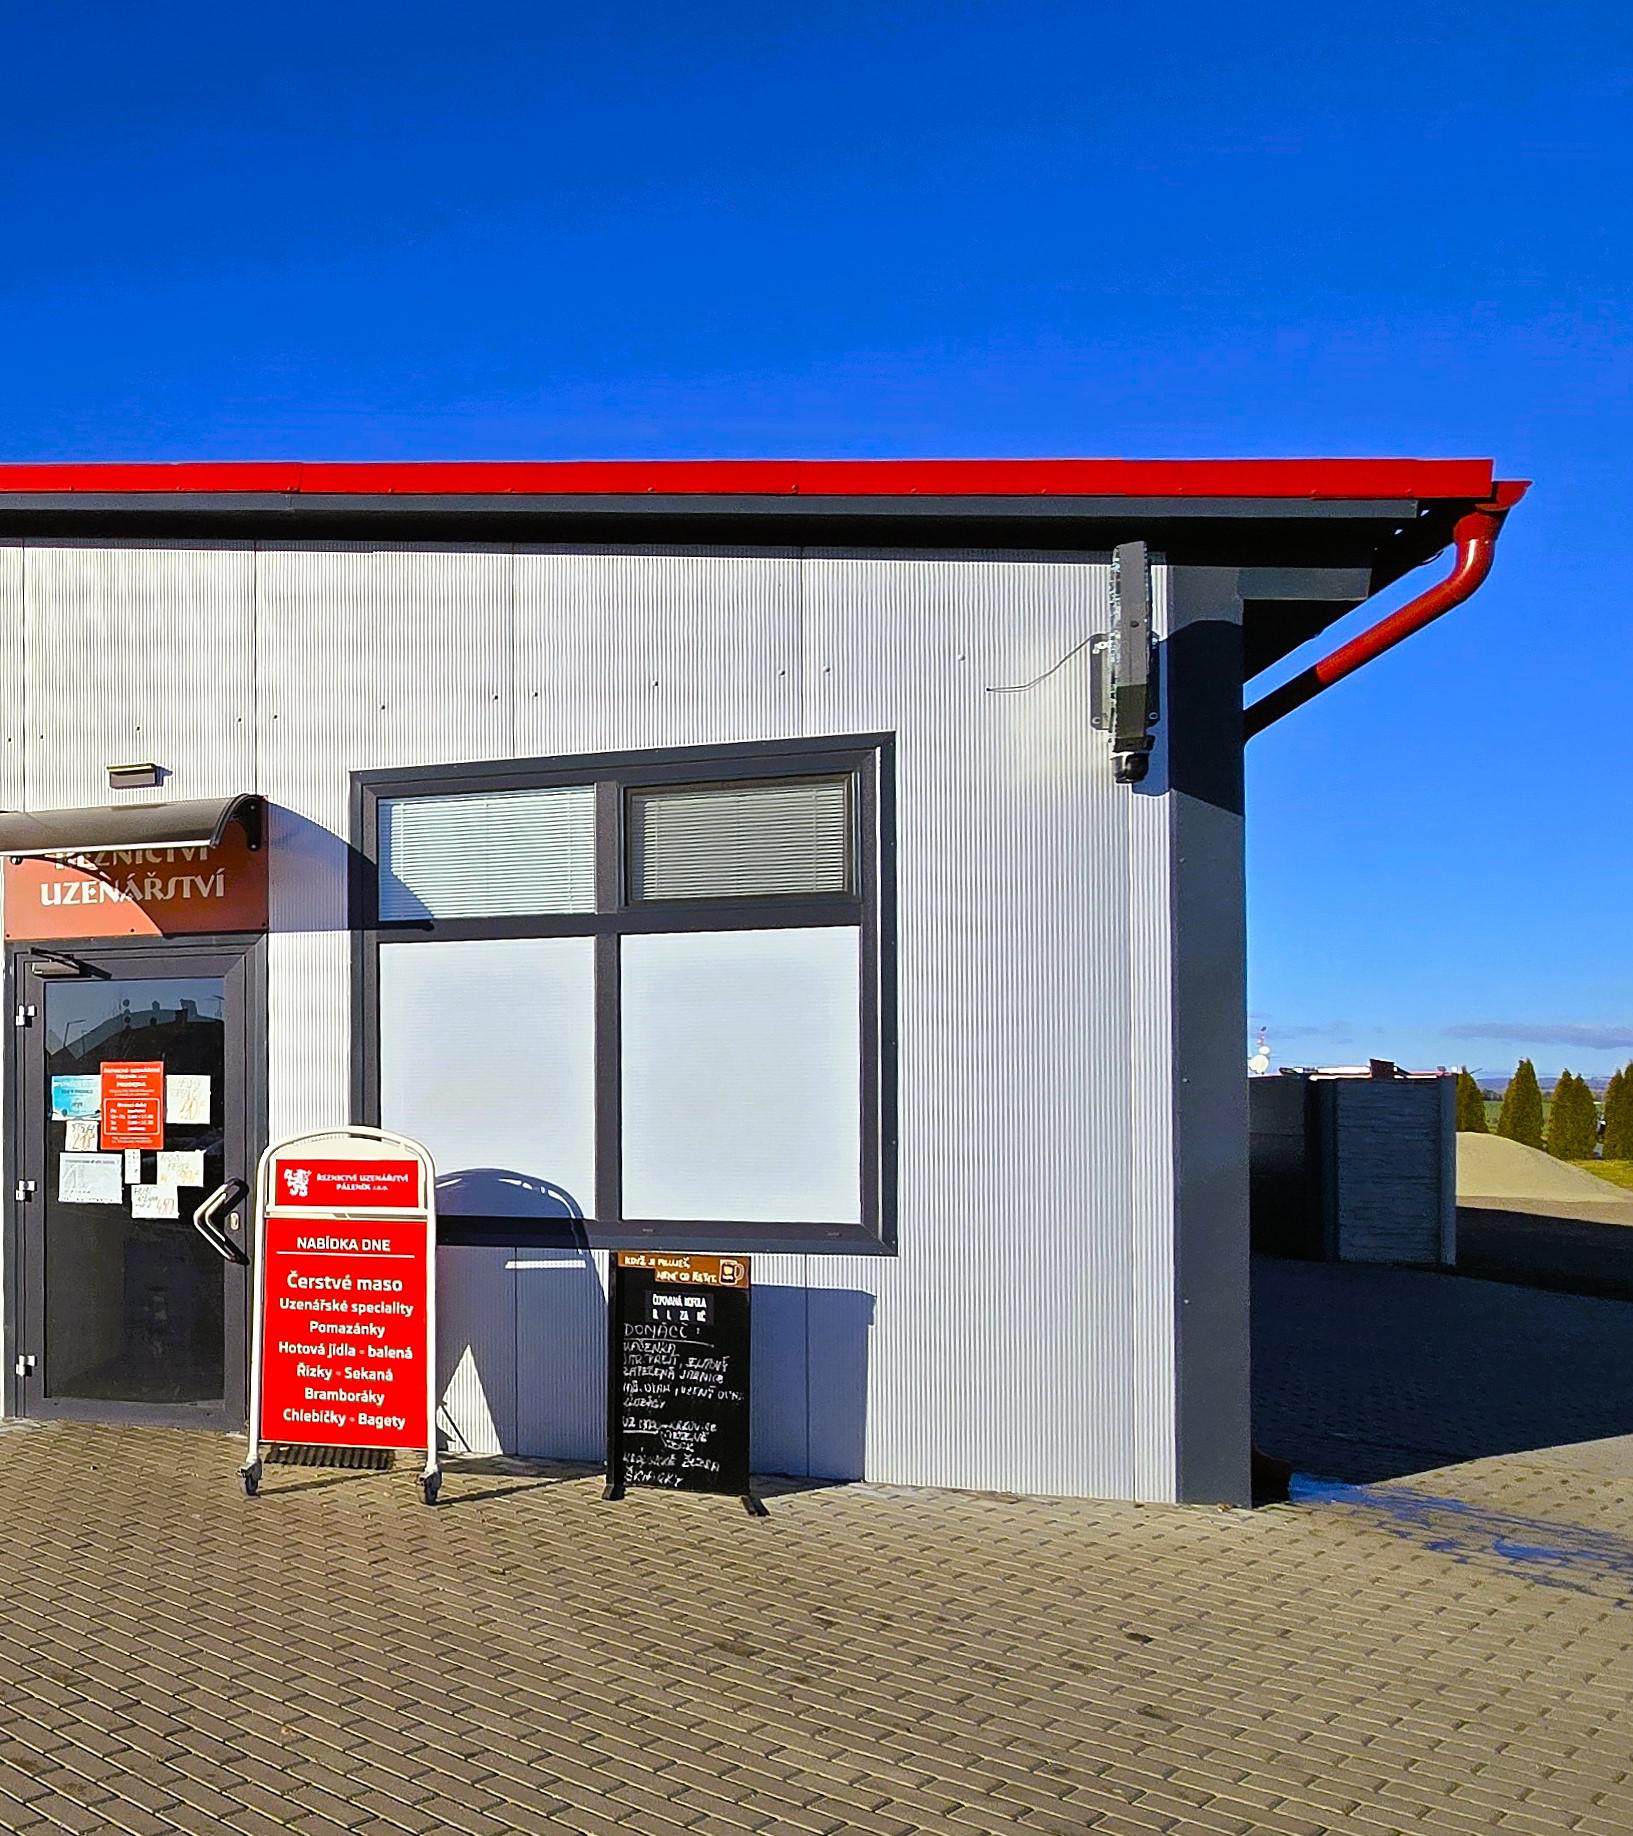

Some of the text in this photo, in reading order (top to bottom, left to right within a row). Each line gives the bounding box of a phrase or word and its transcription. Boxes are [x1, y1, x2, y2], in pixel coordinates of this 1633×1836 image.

[40, 868, 225, 906] UZENÁŘSTVÍ
[296, 1235, 391, 1252] NABÍDKA DNE
[287, 1270, 403, 1292] Čerstvé maso
[279, 1298, 414, 1317] Uzenářské speciality
[309, 1320, 386, 1339] Pomazánky
[278, 1341, 325, 1356] Hotová
[327, 1343, 356, 1359] jídla
[368, 1345, 414, 1360] balená
[296, 1362, 333, 1381] Řízky
[344, 1366, 394, 1382] Sekaná
[304, 1387, 385, 1406] Bramboráky
[283, 1408, 346, 1427] Chlebíčky
[358, 1412, 406, 1430] Bagety
